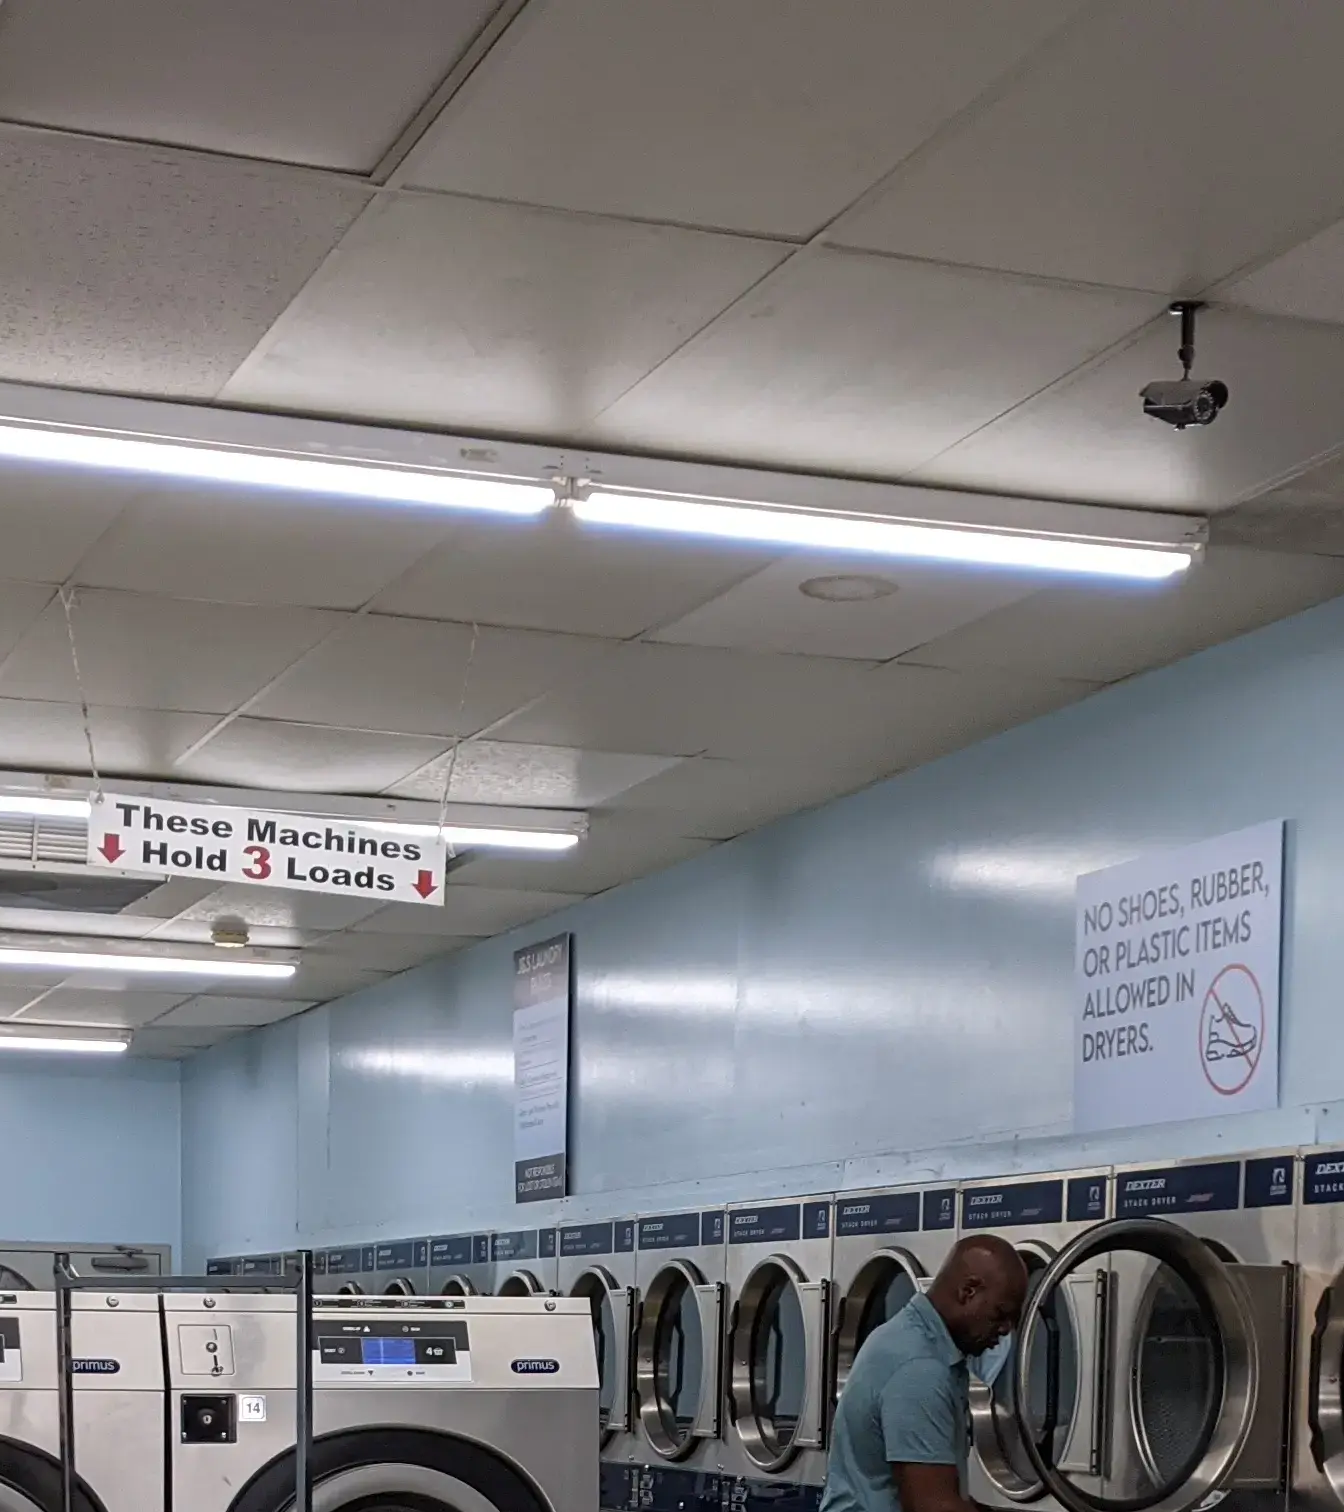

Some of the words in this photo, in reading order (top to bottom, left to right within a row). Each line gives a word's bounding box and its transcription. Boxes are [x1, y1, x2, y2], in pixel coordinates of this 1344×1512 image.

[115, 801, 234, 840] These
[246, 817, 423, 862] Machines
[141, 839, 228, 874] Hold
[240, 845, 273, 882] 3
[285, 856, 397, 893] Loads
[1083, 901, 1114, 936] NO
[1118, 882, 1185, 928] SHOES,
[1190, 860, 1270, 910] RUBBER,
[1082, 944, 1111, 978] OR
[1115, 924, 1190, 972] PLASTIC
[1195, 909, 1252, 955] ITEMS
[1082, 974, 1170, 1021] ALLOWED
[1175, 968, 1196, 1002] IN
[1082, 1021, 1154, 1063] DRYERS.
[1124, 1177, 1167, 1192] DEXTER
[969, 1194, 1004, 1206] DEXTER
[425, 1346, 433, 1356] 4
[71, 1358, 116, 1373] primus
[516, 1359, 555, 1372] primus
[246, 1402, 261, 1414] 14
